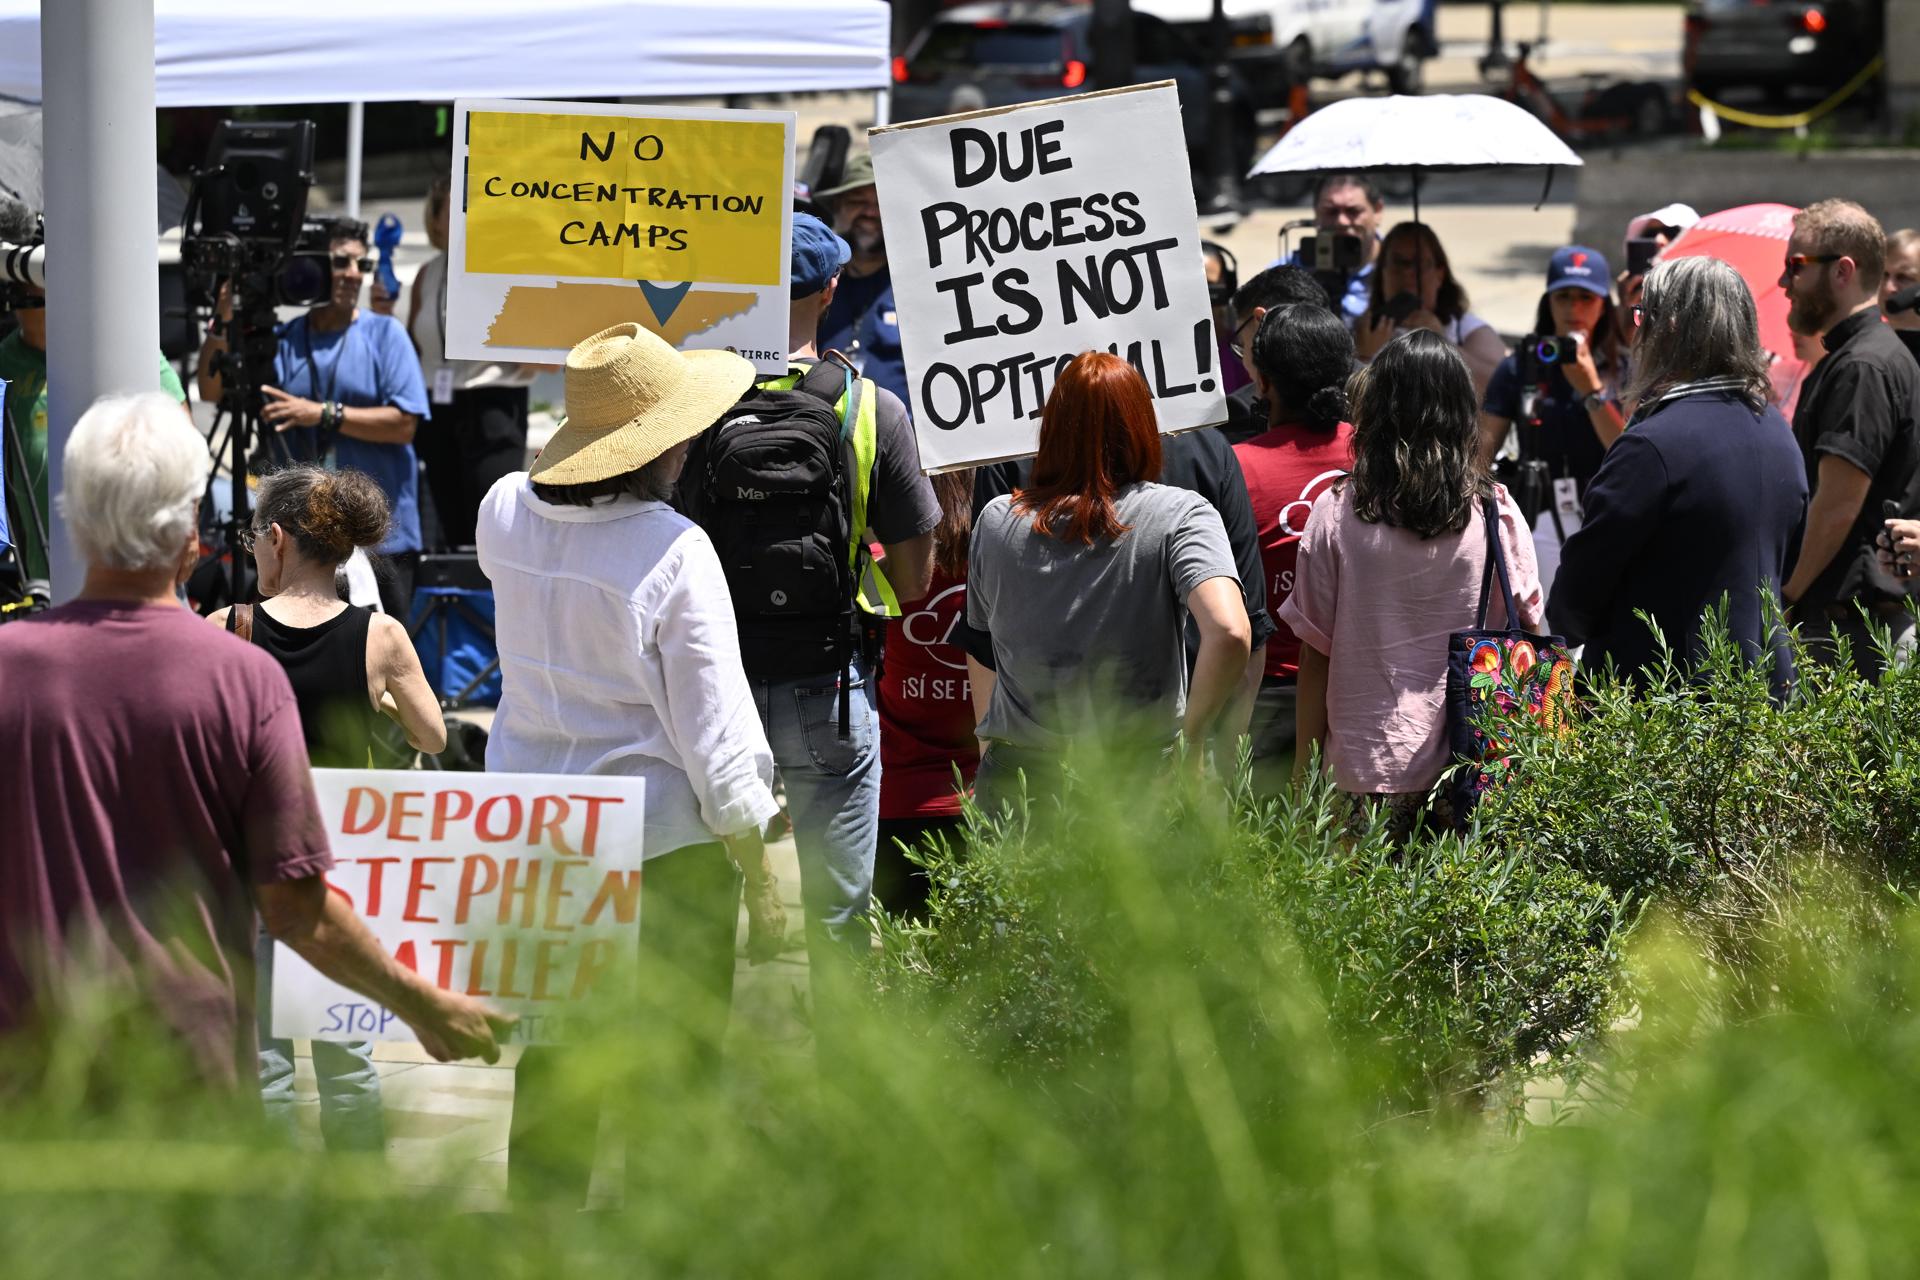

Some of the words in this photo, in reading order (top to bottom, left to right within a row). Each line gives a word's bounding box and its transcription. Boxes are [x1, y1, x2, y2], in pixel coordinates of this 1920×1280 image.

[579, 130, 664, 162] NO
[949, 119, 1073, 188] DUE
[484, 176, 764, 215] CONCENTRATION
[559, 220, 689, 251] CAMPS
[920, 191, 1146, 268] PROCESS
[935, 267, 1044, 345] IS
[1056, 237, 1179, 325] NOT
[740, 349, 780, 361] TIRRC
[921, 318, 1216, 430] OPTIAL!
[931, 679, 956, 700] SE
[340, 786, 625, 858] DEPORT
[318, 1003, 396, 1033] STOP
